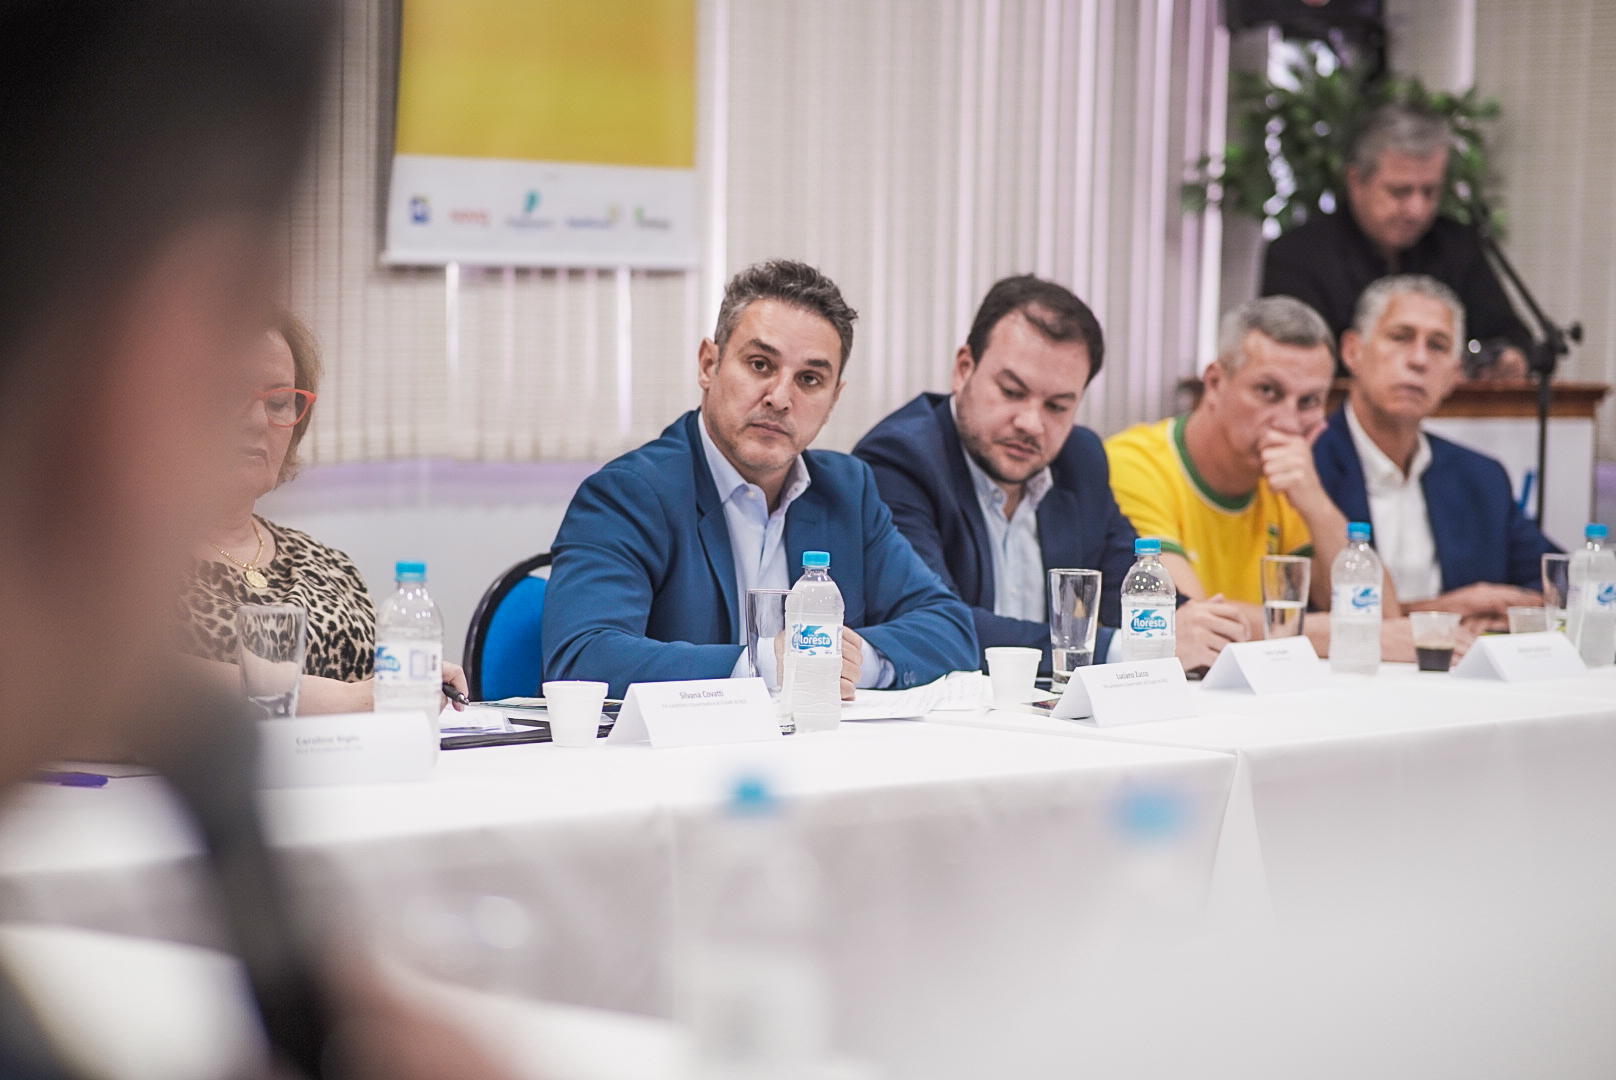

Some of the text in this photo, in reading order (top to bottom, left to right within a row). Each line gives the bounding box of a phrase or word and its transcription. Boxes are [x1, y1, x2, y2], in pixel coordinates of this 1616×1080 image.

[1133, 617, 1166, 627] floresta
[1116, 672, 1134, 680] Luciano
[702, 690, 724, 698] Covatti
